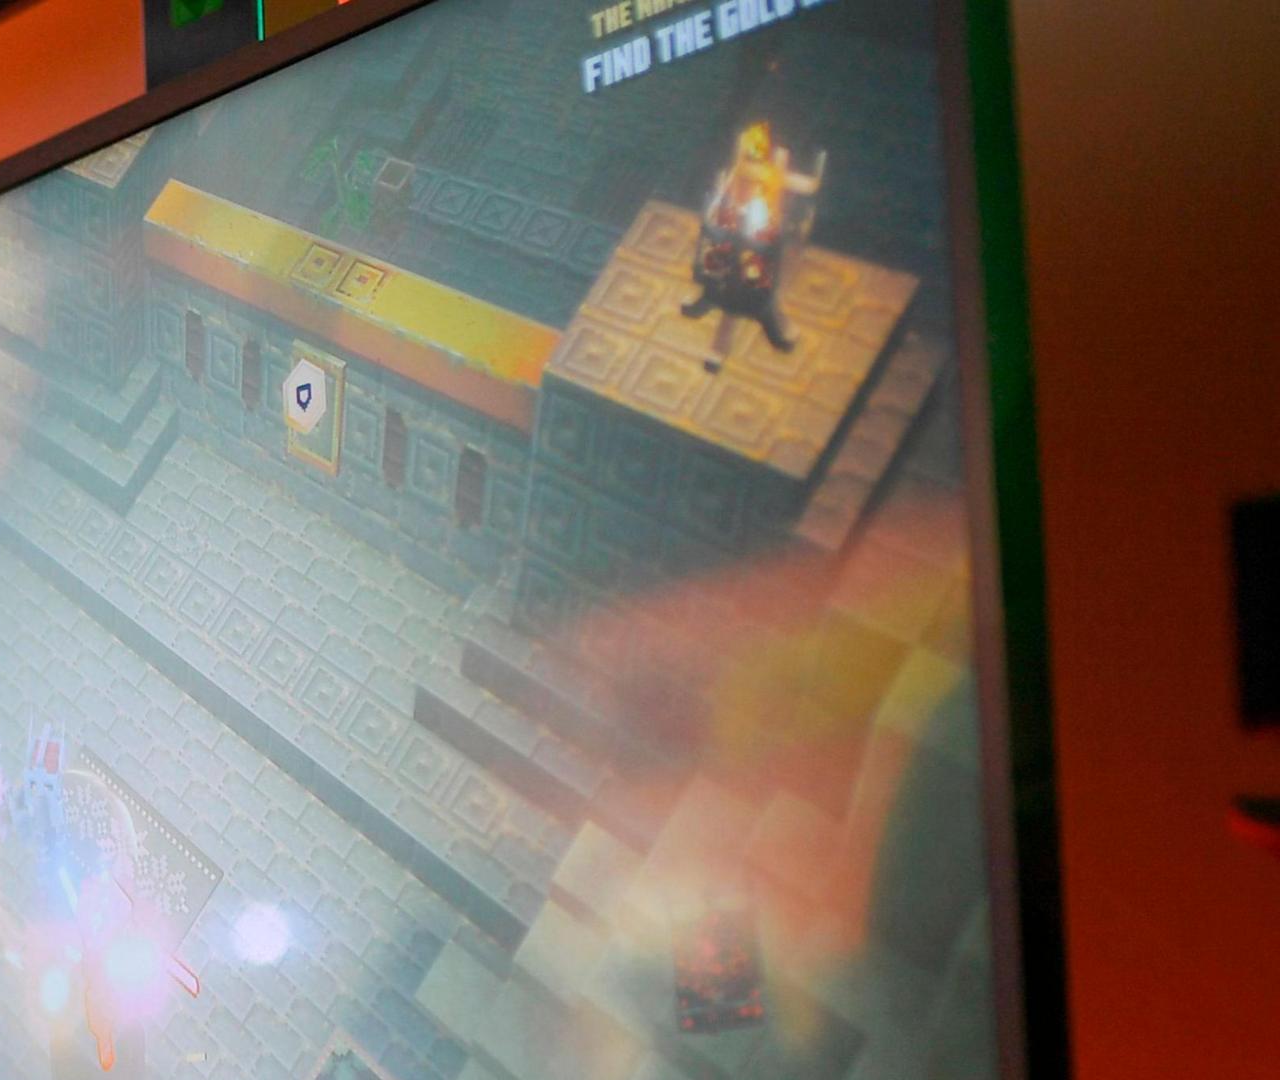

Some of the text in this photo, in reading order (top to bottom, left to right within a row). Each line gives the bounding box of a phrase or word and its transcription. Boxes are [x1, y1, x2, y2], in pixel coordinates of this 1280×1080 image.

[591, 1, 634, 39] THE
[583, 35, 652, 94] FIND
[654, 9, 714, 64] THE
